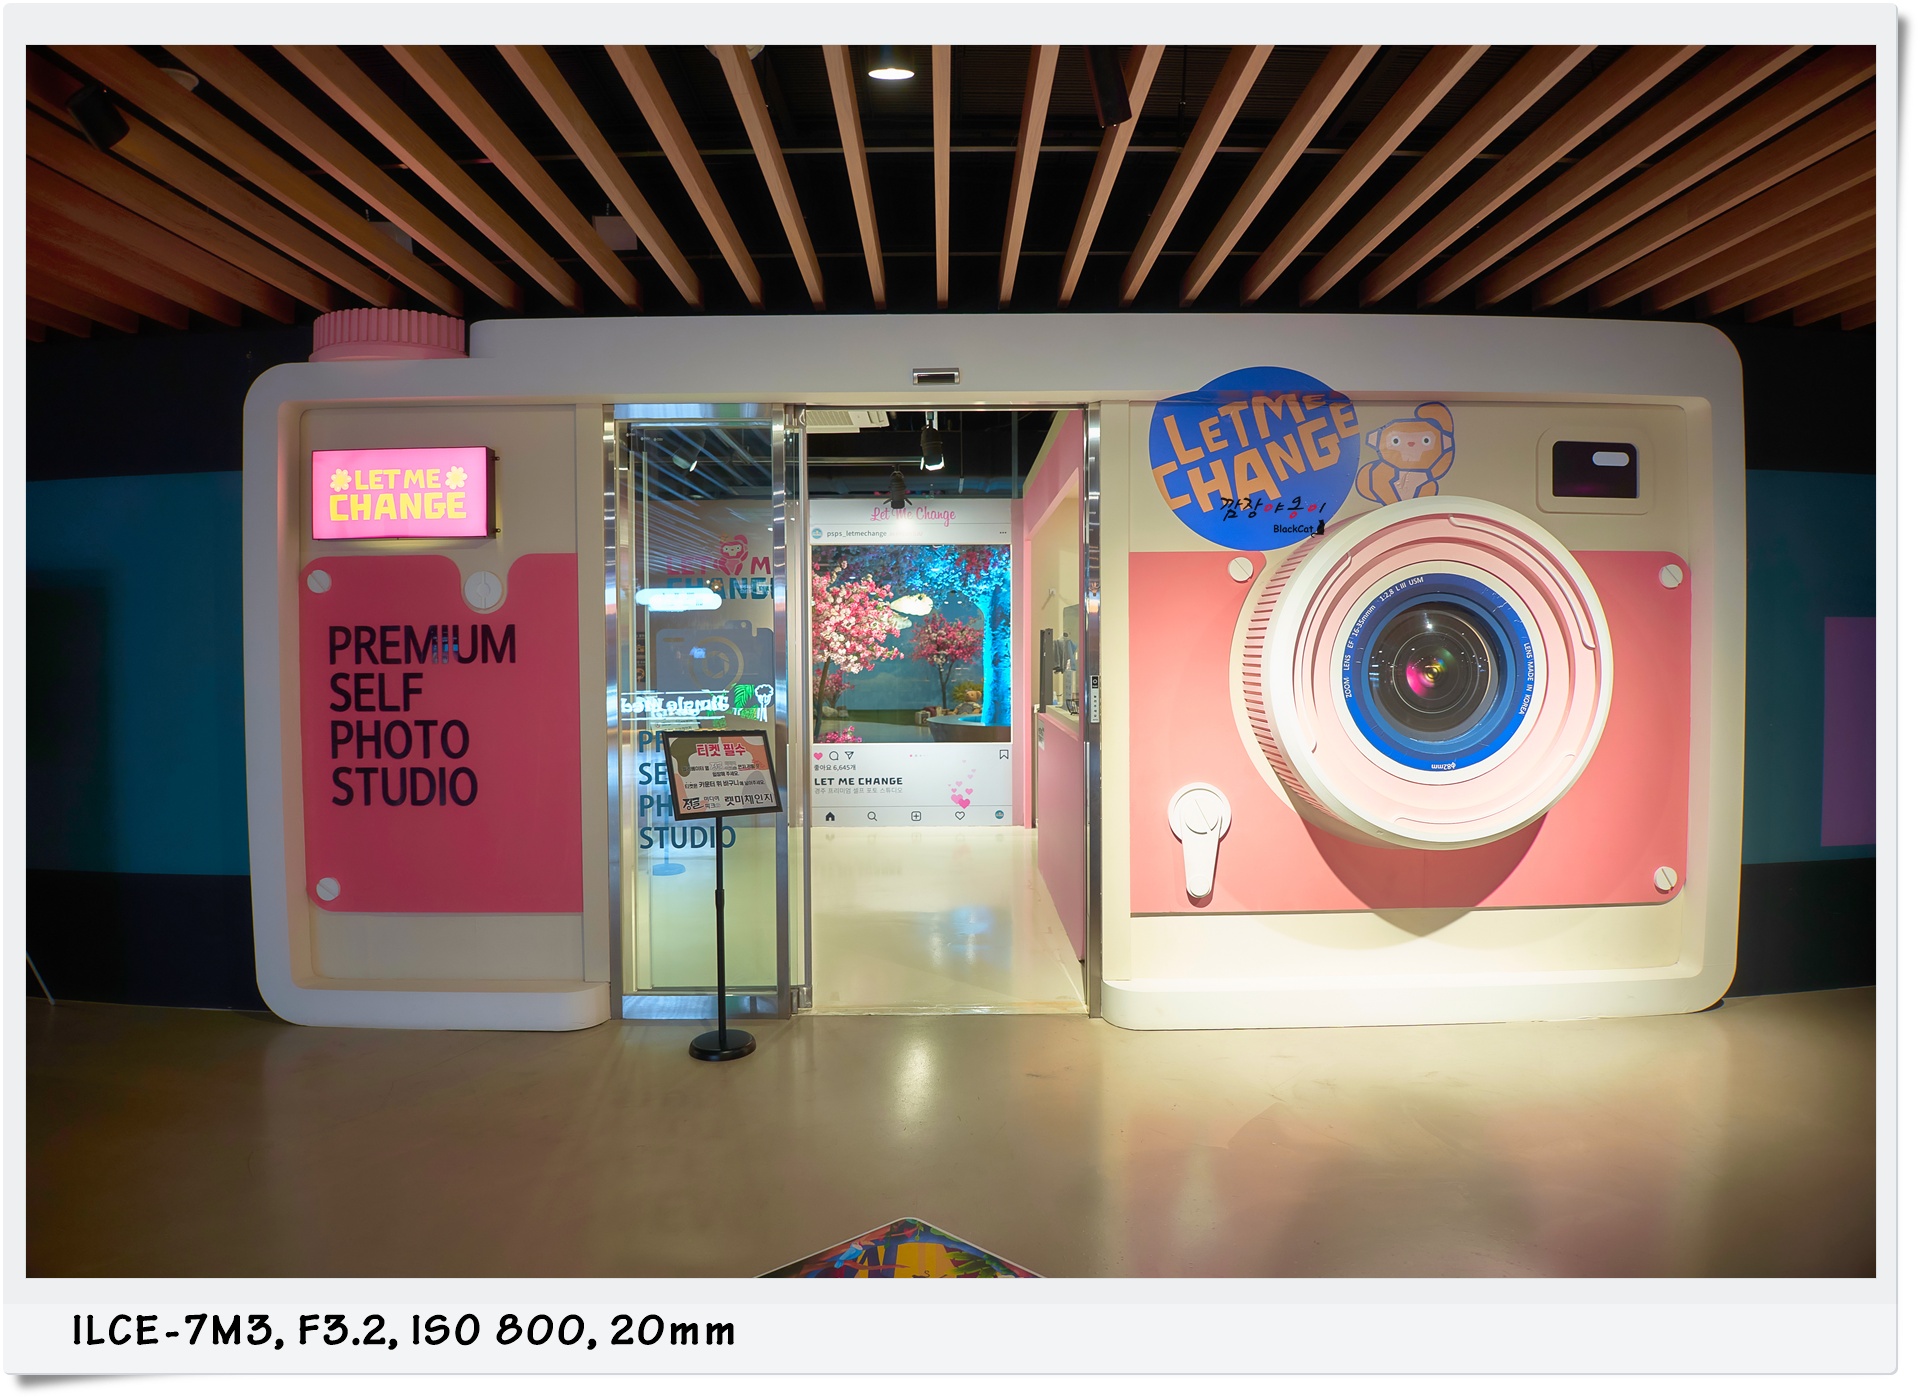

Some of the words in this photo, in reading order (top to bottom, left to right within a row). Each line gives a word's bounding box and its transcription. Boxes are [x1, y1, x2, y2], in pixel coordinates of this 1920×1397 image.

[1163, 401, 1249, 465] LET
[1252, 394, 1326, 439] ME
[1152, 401, 1359, 513] CHANGE
[355, 469, 401, 490] LET
[404, 468, 441, 489] ME
[329, 492, 467, 521] CHANGE
[870, 507, 890, 521] Let
[915, 506, 956, 527] Change
[827, 530, 887, 538] psps_letmechange
[751, 556, 771, 575] M
[1408, 577, 1425, 586] USM
[329, 623, 517, 665] PREMIUM
[1347, 640, 1355, 649] EF
[1523, 642, 1533, 660] LENS
[329, 672, 424, 713] SELF
[1344, 676, 1353, 698] ZOOM
[1525, 683, 1533, 692] IN
[1518, 693, 1532, 715] KOREA
[331, 718, 470, 760] PHOTO
[696, 743, 721, 757] 티켓
[723, 743, 746, 757] 필수
[833, 764, 856, 772] 6,645개
[332, 766, 479, 807] STUDIO
[814, 778, 835, 786] LET
[838, 777, 855, 785] ME
[858, 777, 903, 786] CHANGE
[828, 787, 851, 795] 프리미엄
[852, 787, 864, 795] 셀프
[639, 825, 736, 849] STUDIO
